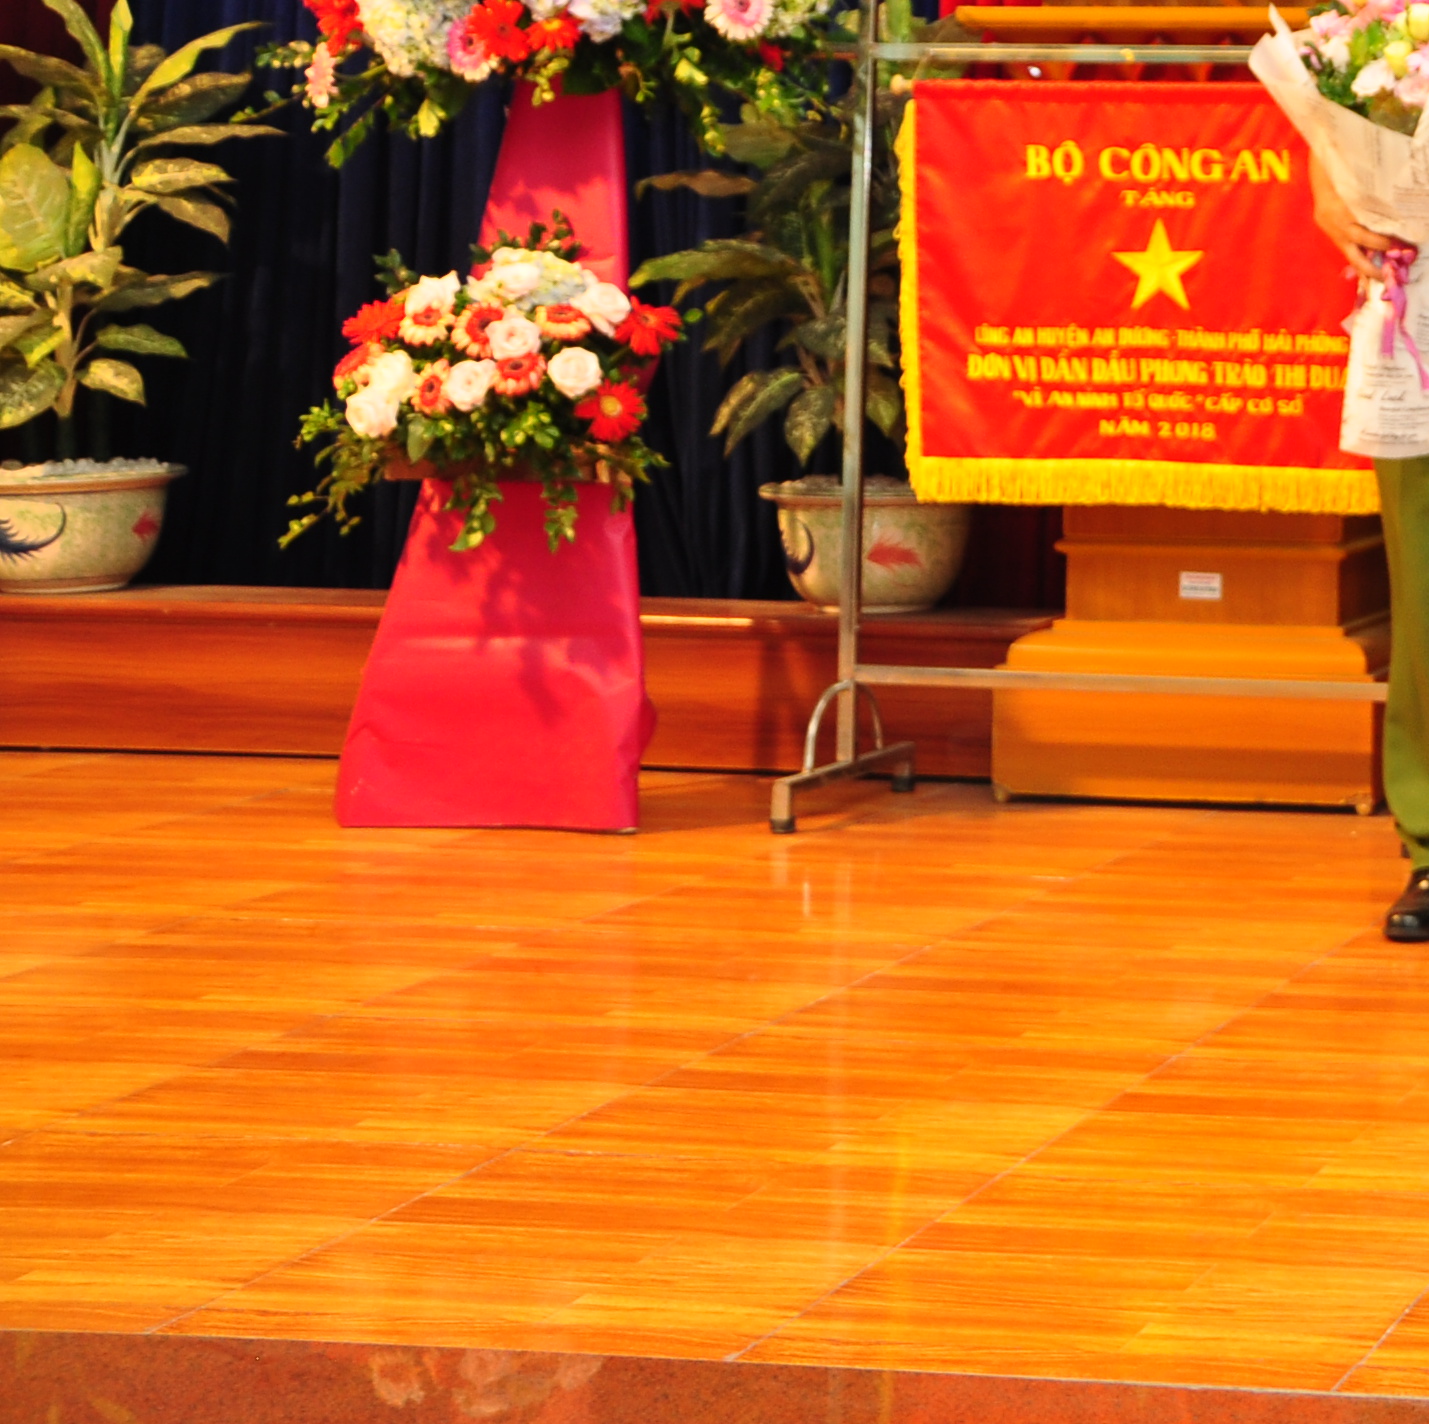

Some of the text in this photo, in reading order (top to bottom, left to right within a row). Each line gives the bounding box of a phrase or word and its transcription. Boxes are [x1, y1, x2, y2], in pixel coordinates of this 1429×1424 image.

[1025, 140, 1290, 186] BỘ CÔNG AN
[1099, 416, 1217, 442] NĂM 2018
